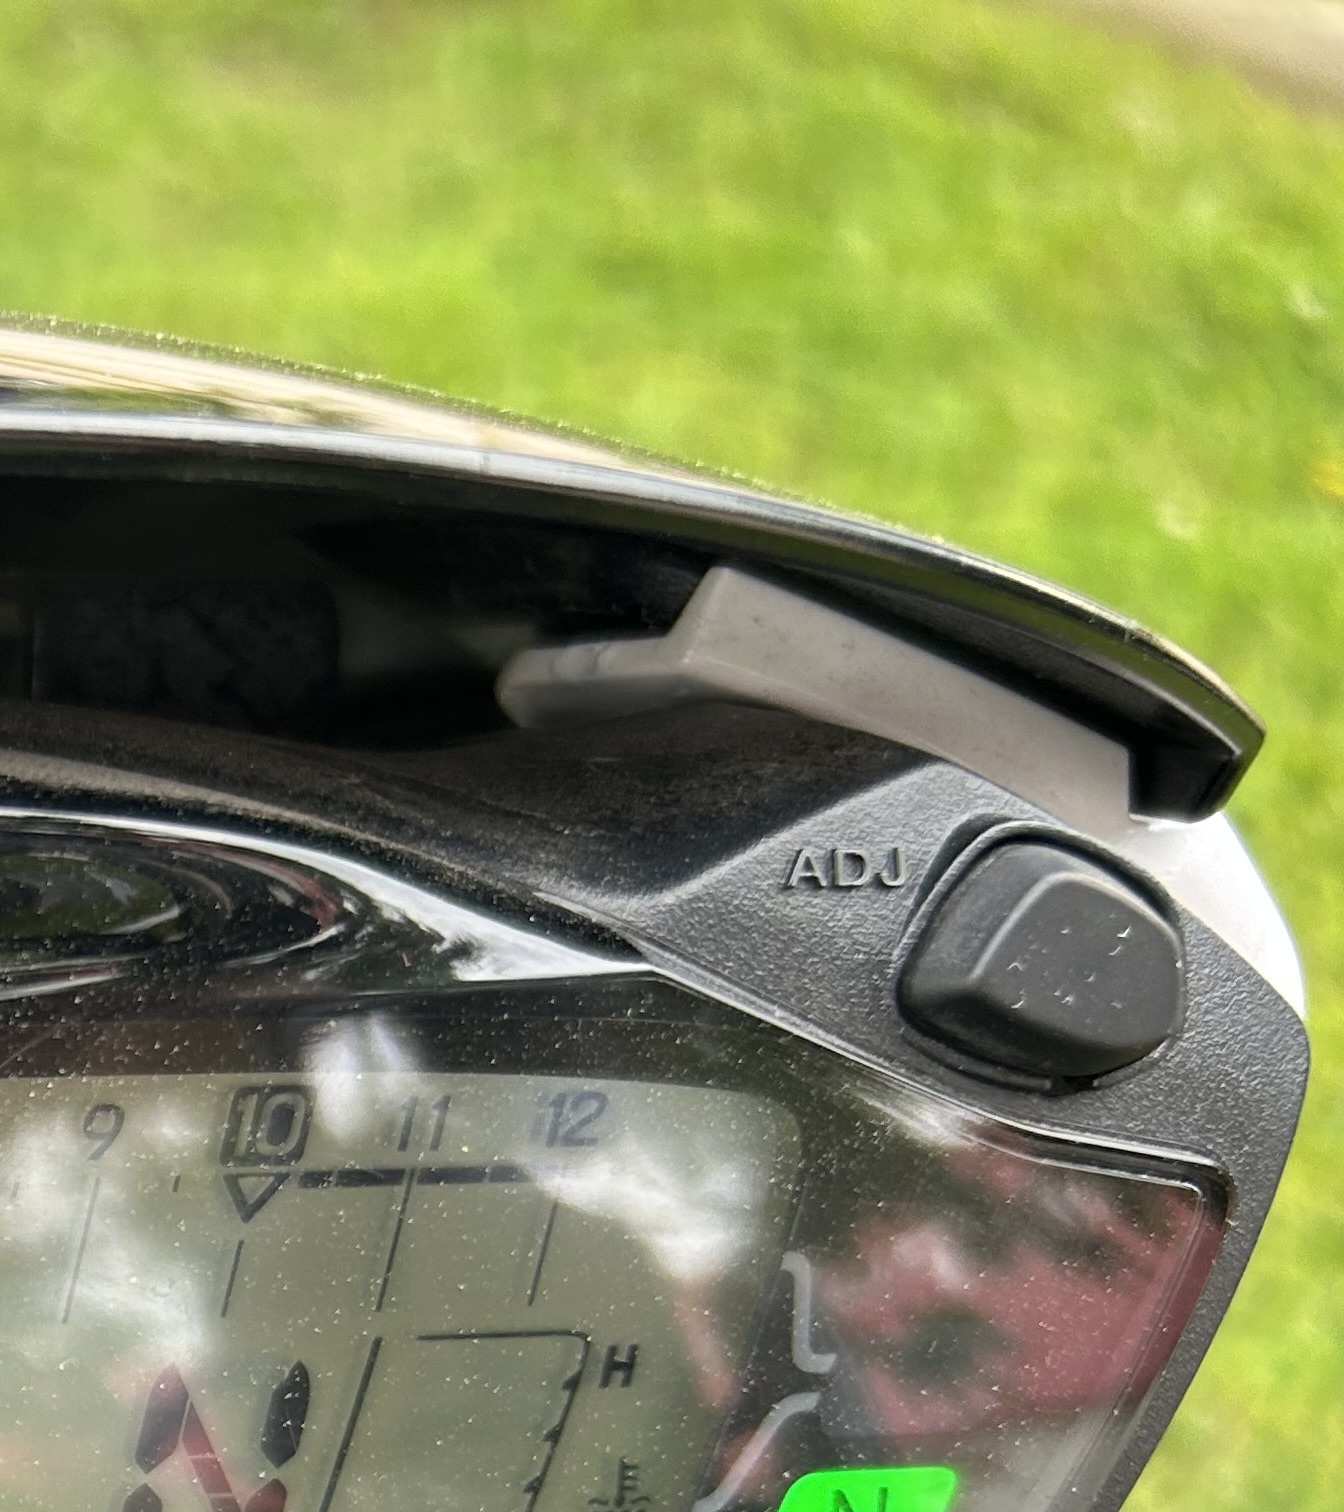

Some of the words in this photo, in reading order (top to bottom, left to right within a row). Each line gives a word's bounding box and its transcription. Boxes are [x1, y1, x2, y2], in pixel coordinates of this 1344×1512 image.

[784, 846, 909, 890] ADJ
[82, 1102, 126, 1162] 9
[230, 1089, 303, 1162] 10
[396, 1094, 453, 1154] 11
[542, 1089, 611, 1149] 12
[598, 1343, 639, 1389] H
